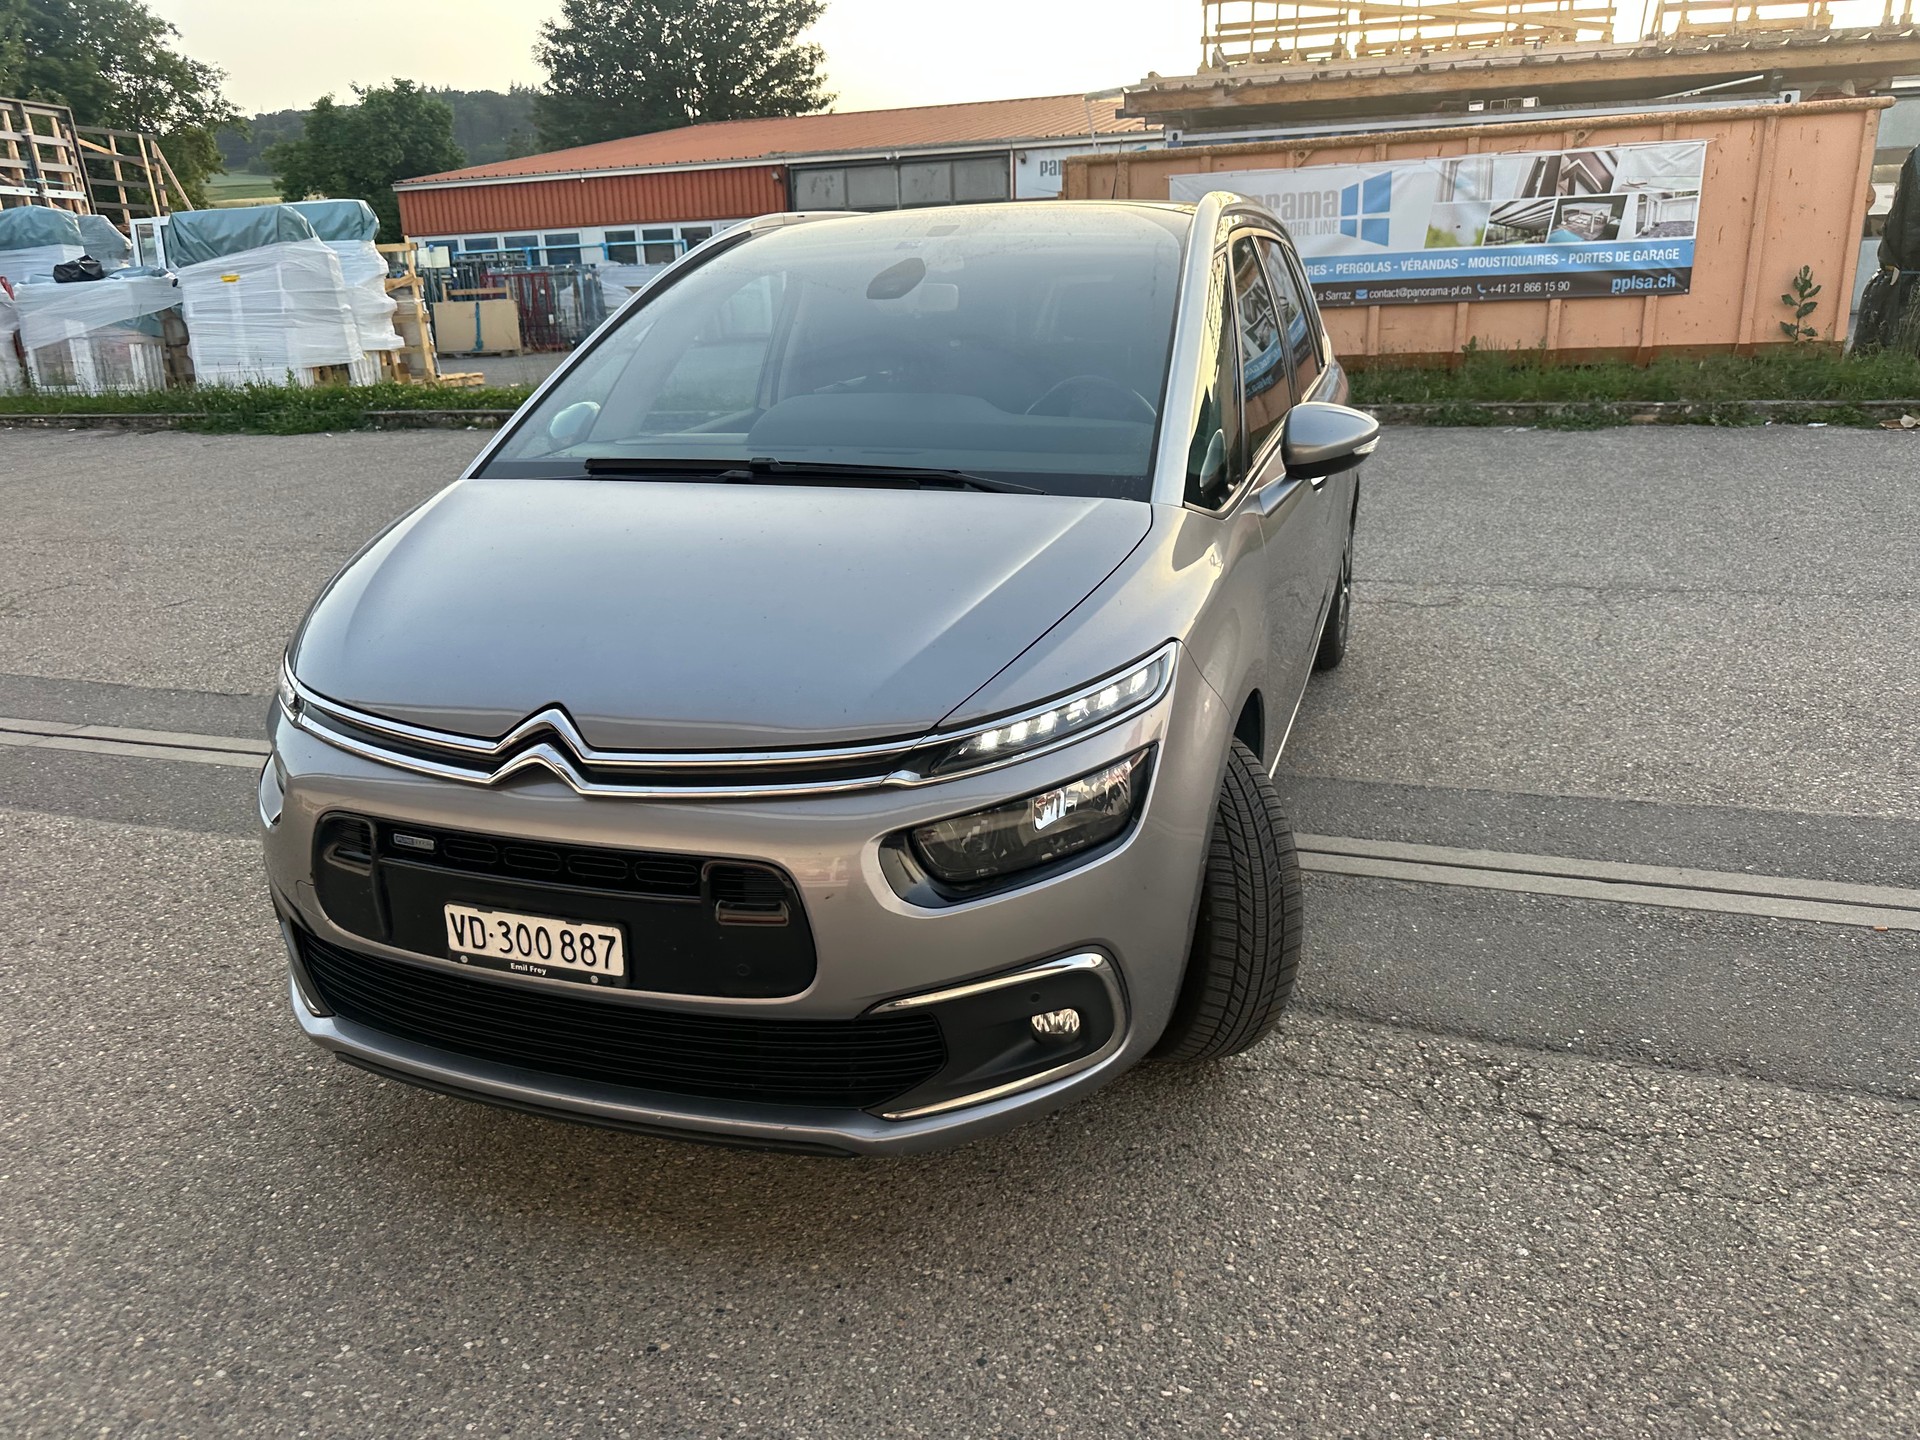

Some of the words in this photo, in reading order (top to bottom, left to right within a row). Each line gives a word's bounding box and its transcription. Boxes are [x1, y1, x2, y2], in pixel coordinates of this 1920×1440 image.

[1314, 219, 1338, 235] LINE
[1304, 264, 1327, 276] RES
[1335, 261, 1392, 274] PERGOLAS
[1400, 256, 1459, 272] VÉRANDAS
[1467, 253, 1559, 268] MOUSTIQUAIRES
[1568, 251, 1613, 265] PORTES
[1615, 250, 1631, 263] DE
[1633, 248, 1680, 262] GARAGE
[1489, 284, 1507, 294] +41
[1509, 283, 1521, 293] 21
[1523, 282, 1542, 293] 866
[1544, 281, 1556, 292] 15
[1557, 281, 1571, 292] 90
[1611, 273, 1677, 295] pplsa.ch
[1325, 290, 1352, 301] Sarraz
[1369, 285, 1472, 300] contact@panorama-pl.ch
[559, 929, 617, 970] 887
[510, 962, 528, 973] Emil
[529, 965, 547, 976] Frey
